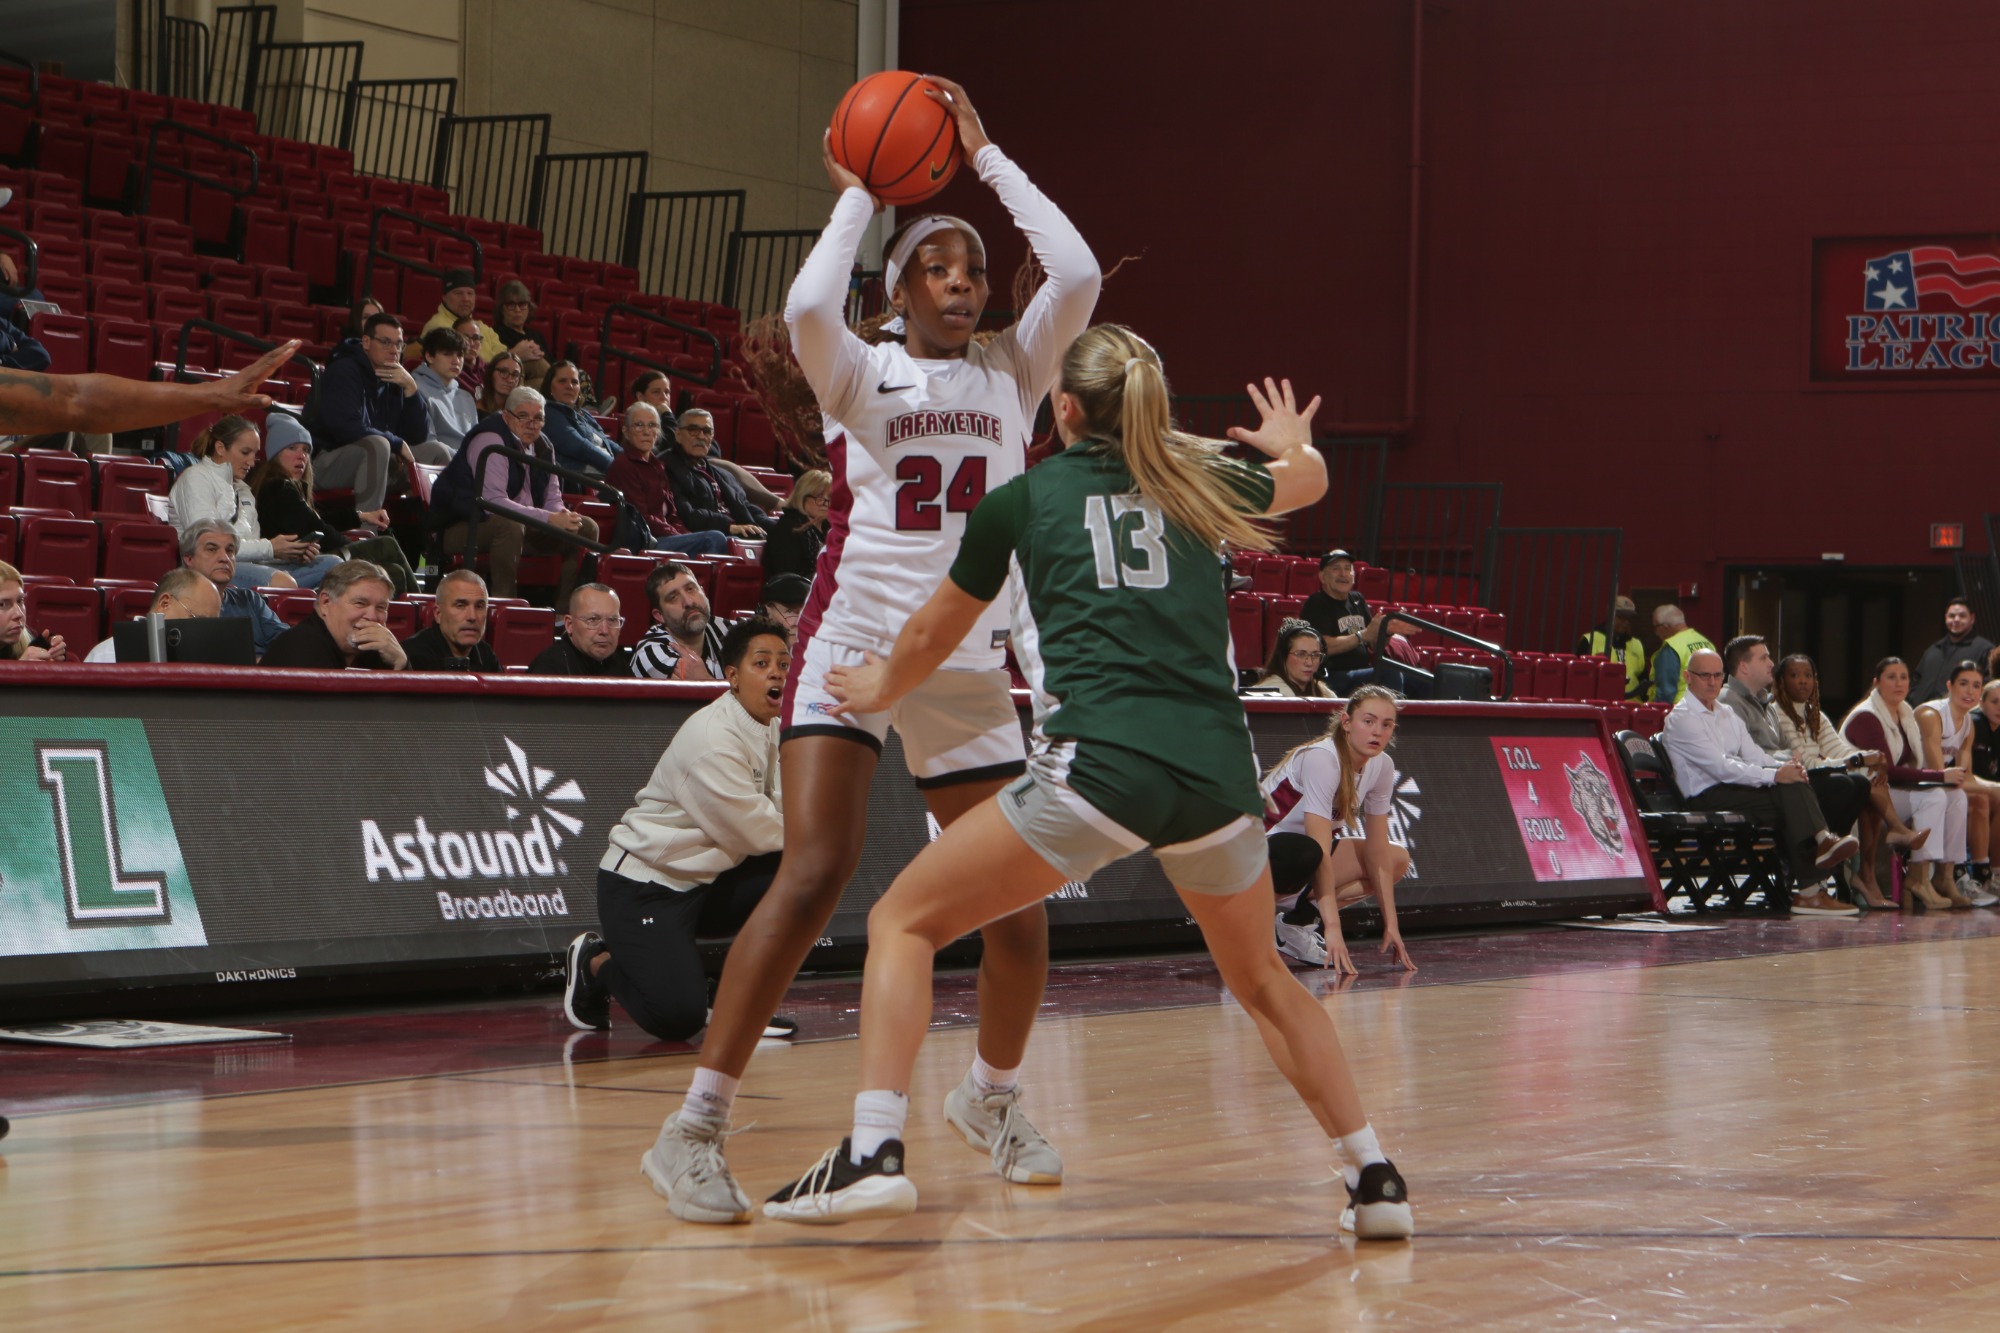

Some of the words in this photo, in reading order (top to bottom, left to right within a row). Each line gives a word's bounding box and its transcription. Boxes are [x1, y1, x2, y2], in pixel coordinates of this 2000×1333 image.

[886, 410, 1002, 448] LAFAYETTE
[895, 455, 988, 531] 24
[1084, 494, 1170, 590] 13
[1527, 780, 1540, 806] 4
[34, 739, 172, 929] L
[360, 815, 556, 883] Astound
[1523, 818, 1566, 843] FOULS
[437, 888, 568, 921] Broadband
[216, 968, 297, 983] DAKTRONICS
